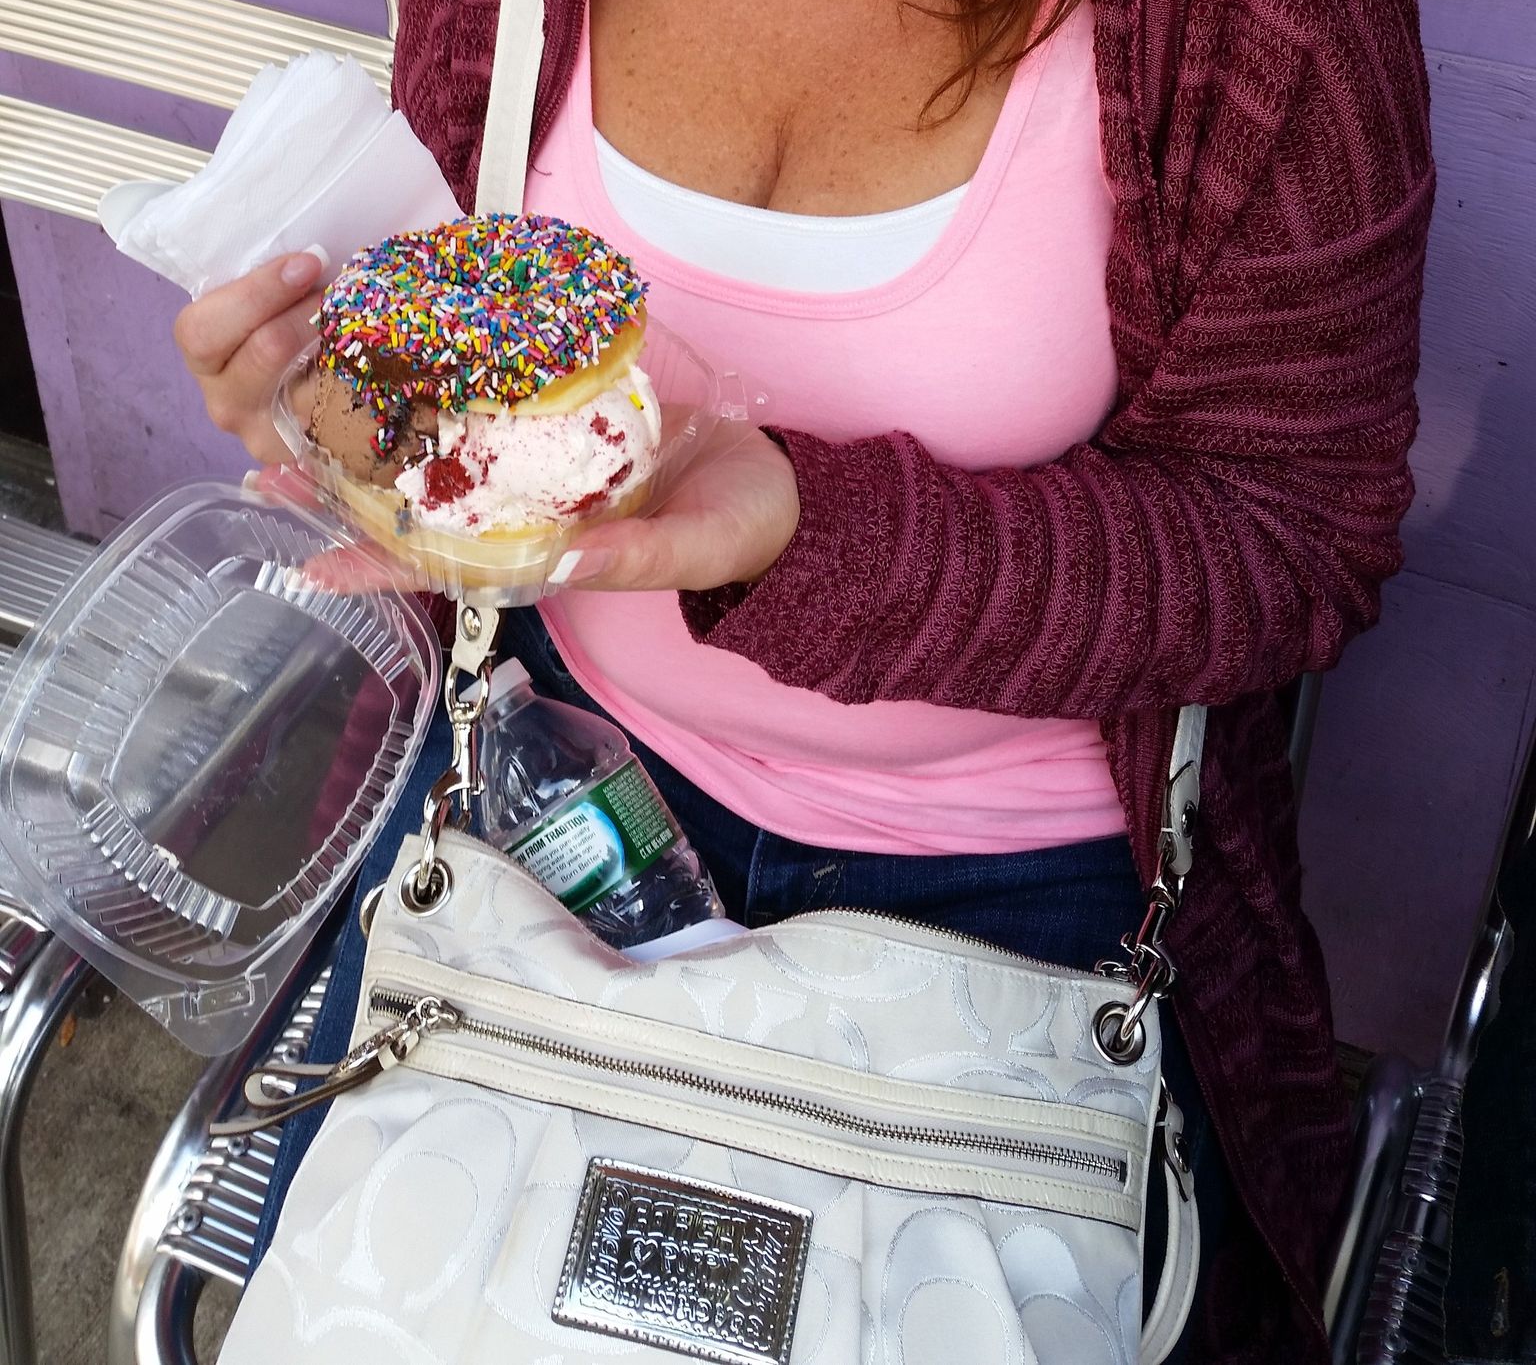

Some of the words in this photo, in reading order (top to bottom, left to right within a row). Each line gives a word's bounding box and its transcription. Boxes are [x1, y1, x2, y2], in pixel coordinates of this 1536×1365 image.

[525, 839, 546, 859] FROM
[544, 814, 589, 843] TRADITION
[560, 868, 578, 883] Born
